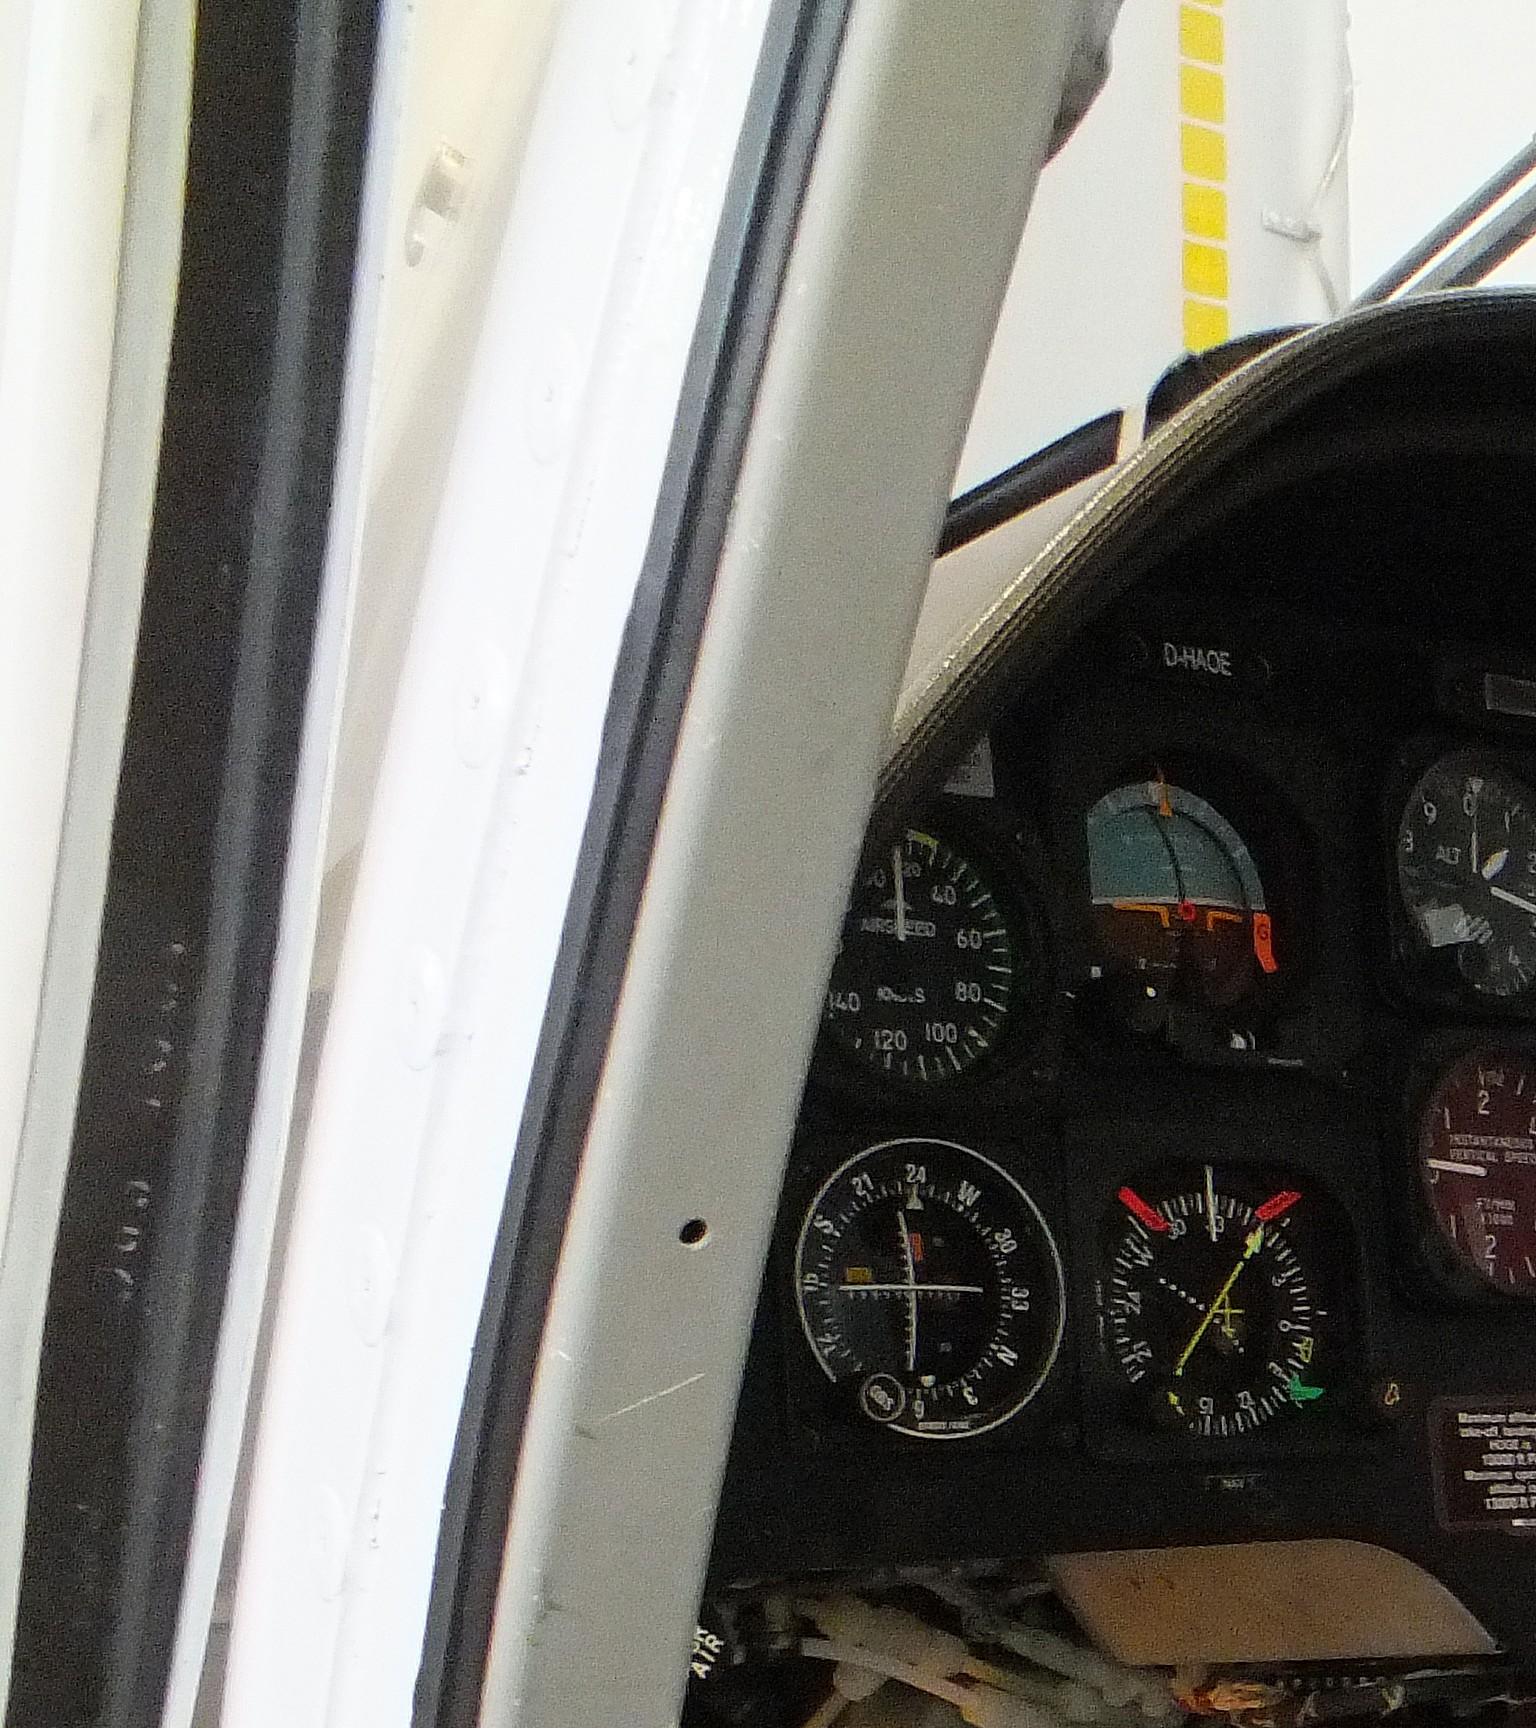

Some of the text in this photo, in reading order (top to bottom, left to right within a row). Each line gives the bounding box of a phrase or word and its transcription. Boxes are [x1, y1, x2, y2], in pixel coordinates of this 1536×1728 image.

[931, 885, 956, 905] 40
[957, 929, 982, 949] 60
[955, 982, 981, 1002] 80
[874, 1030, 907, 1051] 120
[925, 1022, 957, 1044] 100
[1477, 1090, 1490, 1115] 2
[906, 1164, 927, 1184] 24
[957, 1179, 982, 1206] W
[995, 1228, 1018, 1254] 30
[1485, 1234, 1497, 1259] 2
[1011, 1287, 1030, 1312] 33
[996, 1344, 1019, 1367] N
[691, 1634, 725, 1680] AIR
